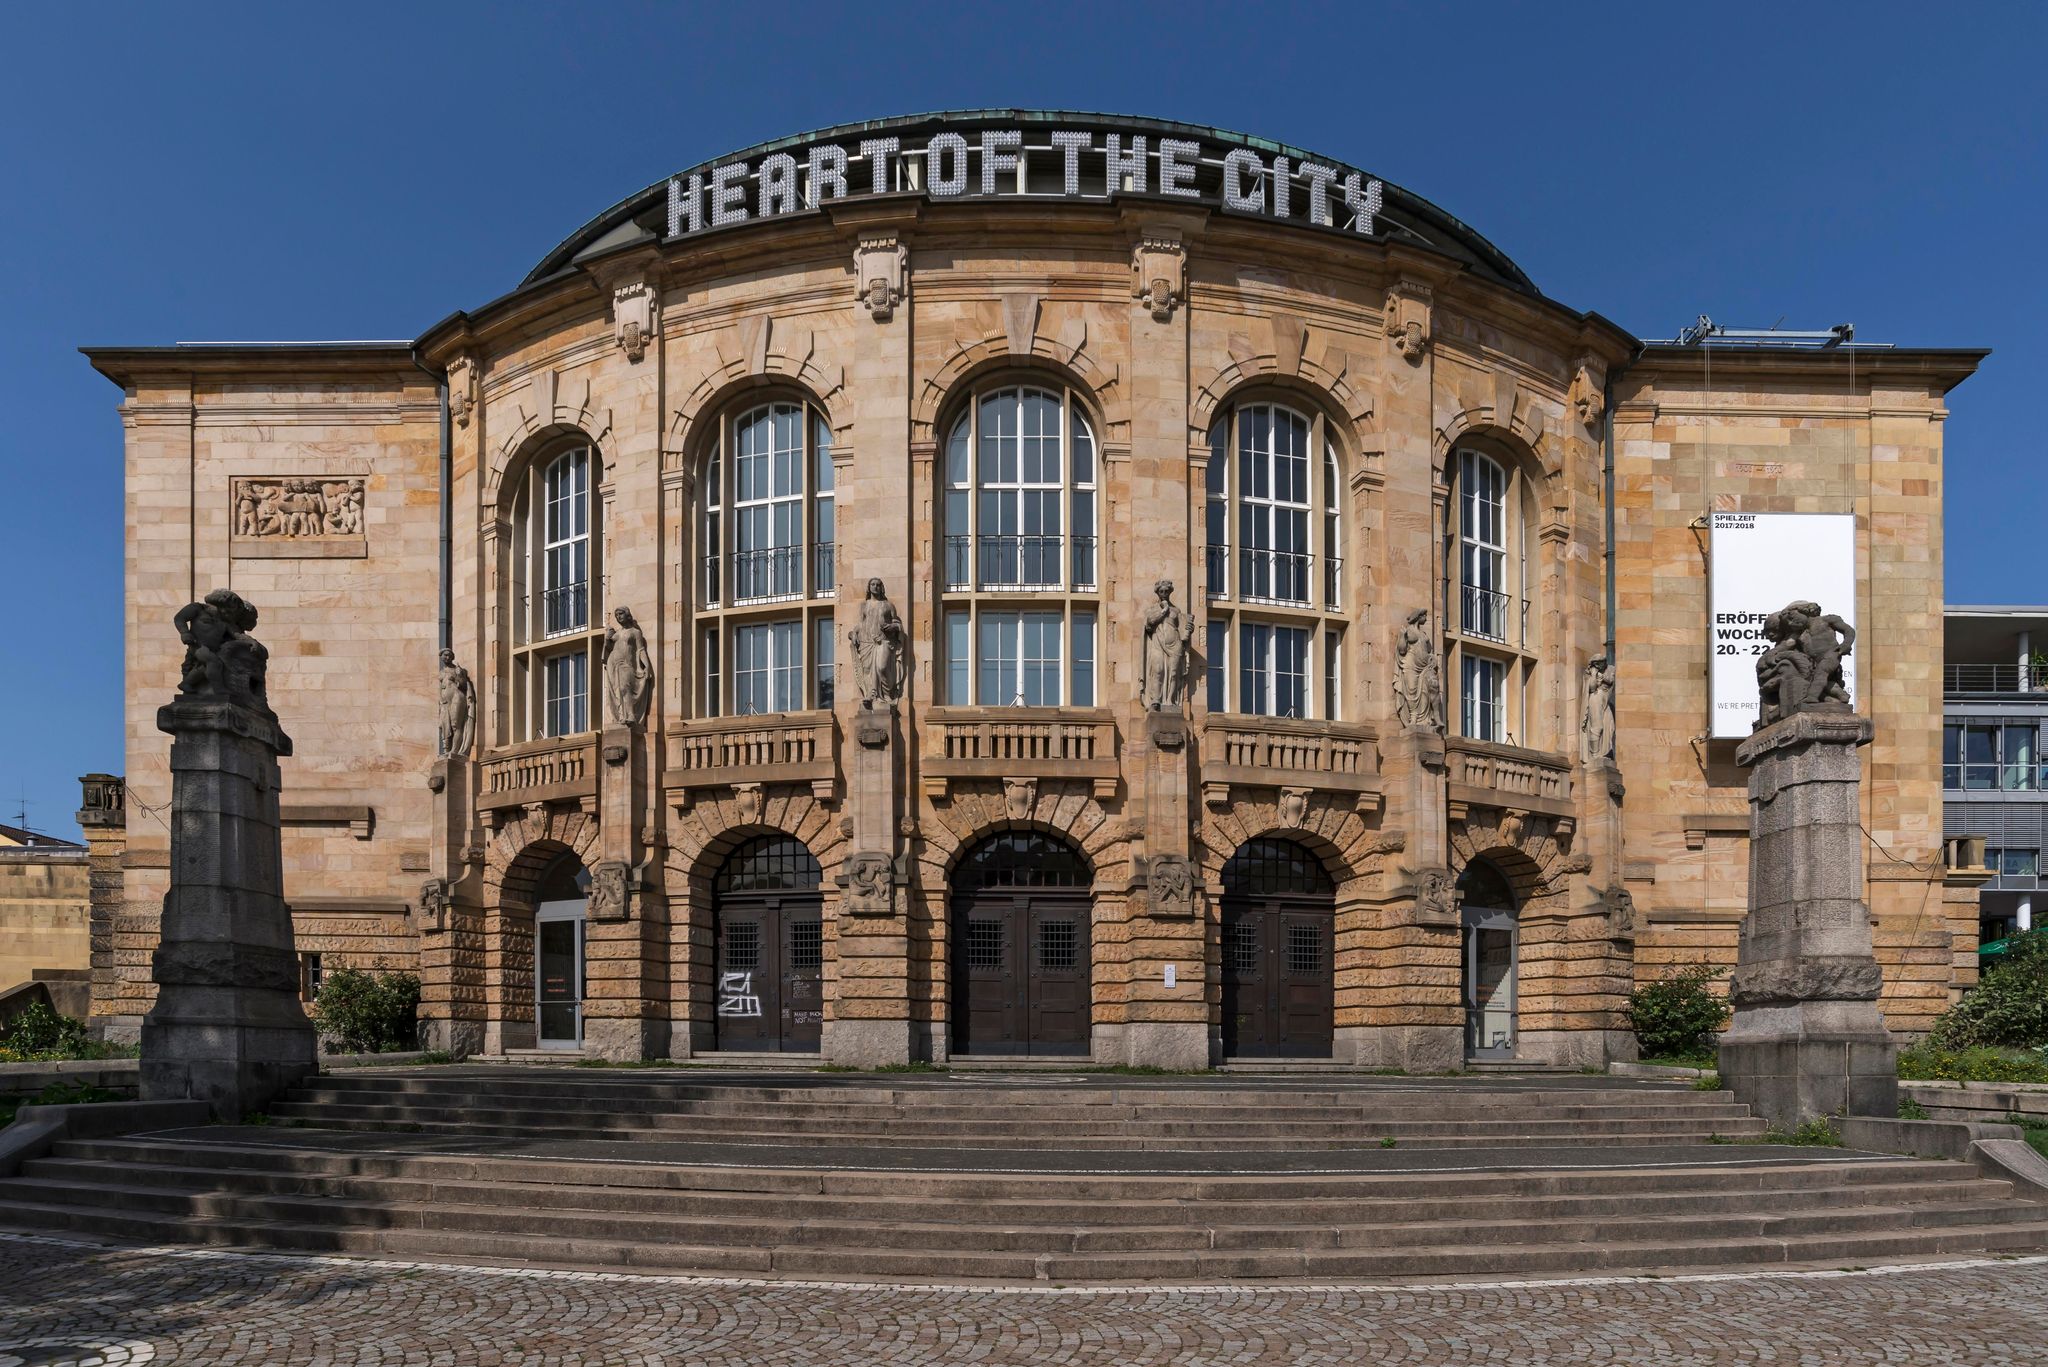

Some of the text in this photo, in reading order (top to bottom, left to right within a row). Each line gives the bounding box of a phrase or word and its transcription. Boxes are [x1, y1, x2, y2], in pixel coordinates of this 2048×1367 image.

[668, 131, 1383, 238] HEART OF THE CITY
[1714, 514, 1757, 522] SPIELZEIT
[1716, 611, 1770, 624] ERÖFF
[1716, 629, 1769, 640] WOCH
[1716, 644, 1740, 655] 20.
